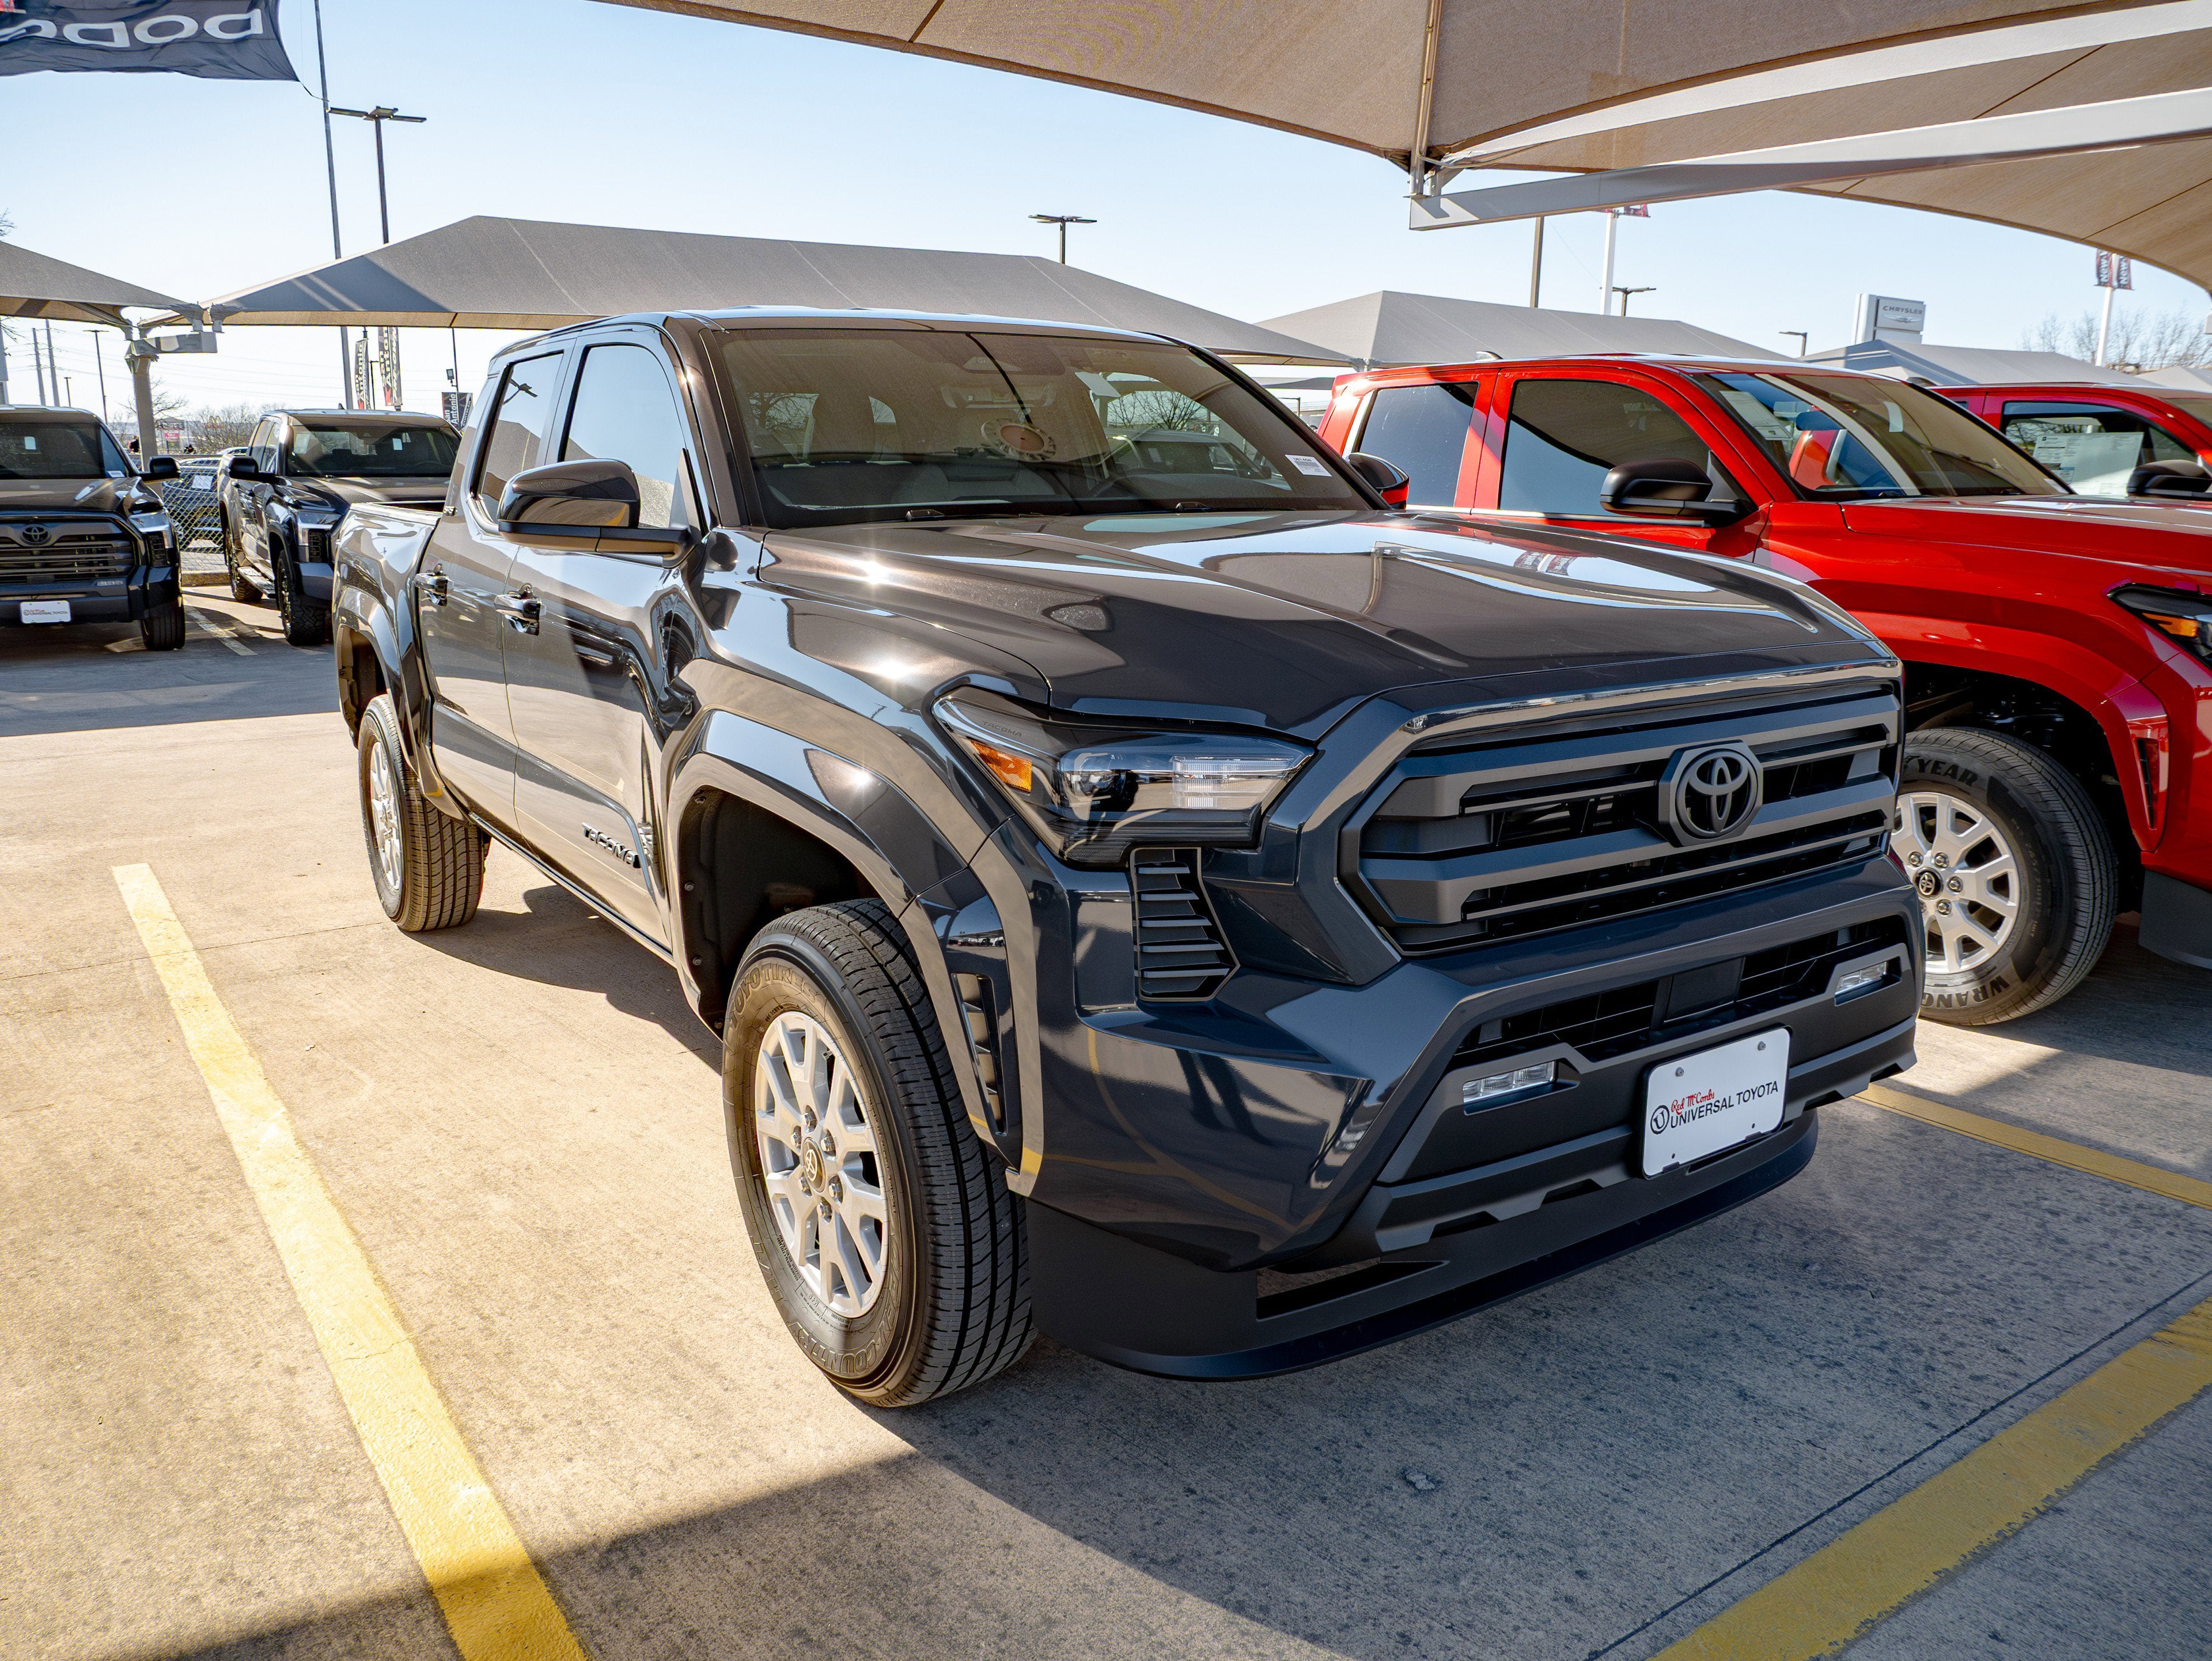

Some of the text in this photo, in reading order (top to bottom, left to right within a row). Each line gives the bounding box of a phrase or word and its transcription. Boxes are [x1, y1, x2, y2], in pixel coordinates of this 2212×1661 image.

[1883, 305, 1923, 315] CHRYSLER
[449, 394, 459, 425] Antonio
[982, 720, 1022, 737] TACOMA
[581, 822, 641, 869] TACOMA
[729, 963, 820, 1029] TOYO TIRES
[1670, 1097, 1734, 1129] UNIVERSAL
[1736, 1080, 1779, 1105] TOYOTA
[1671, 1098, 1685, 1115] Red
[789, 1322, 877, 1374] COUNTRY
